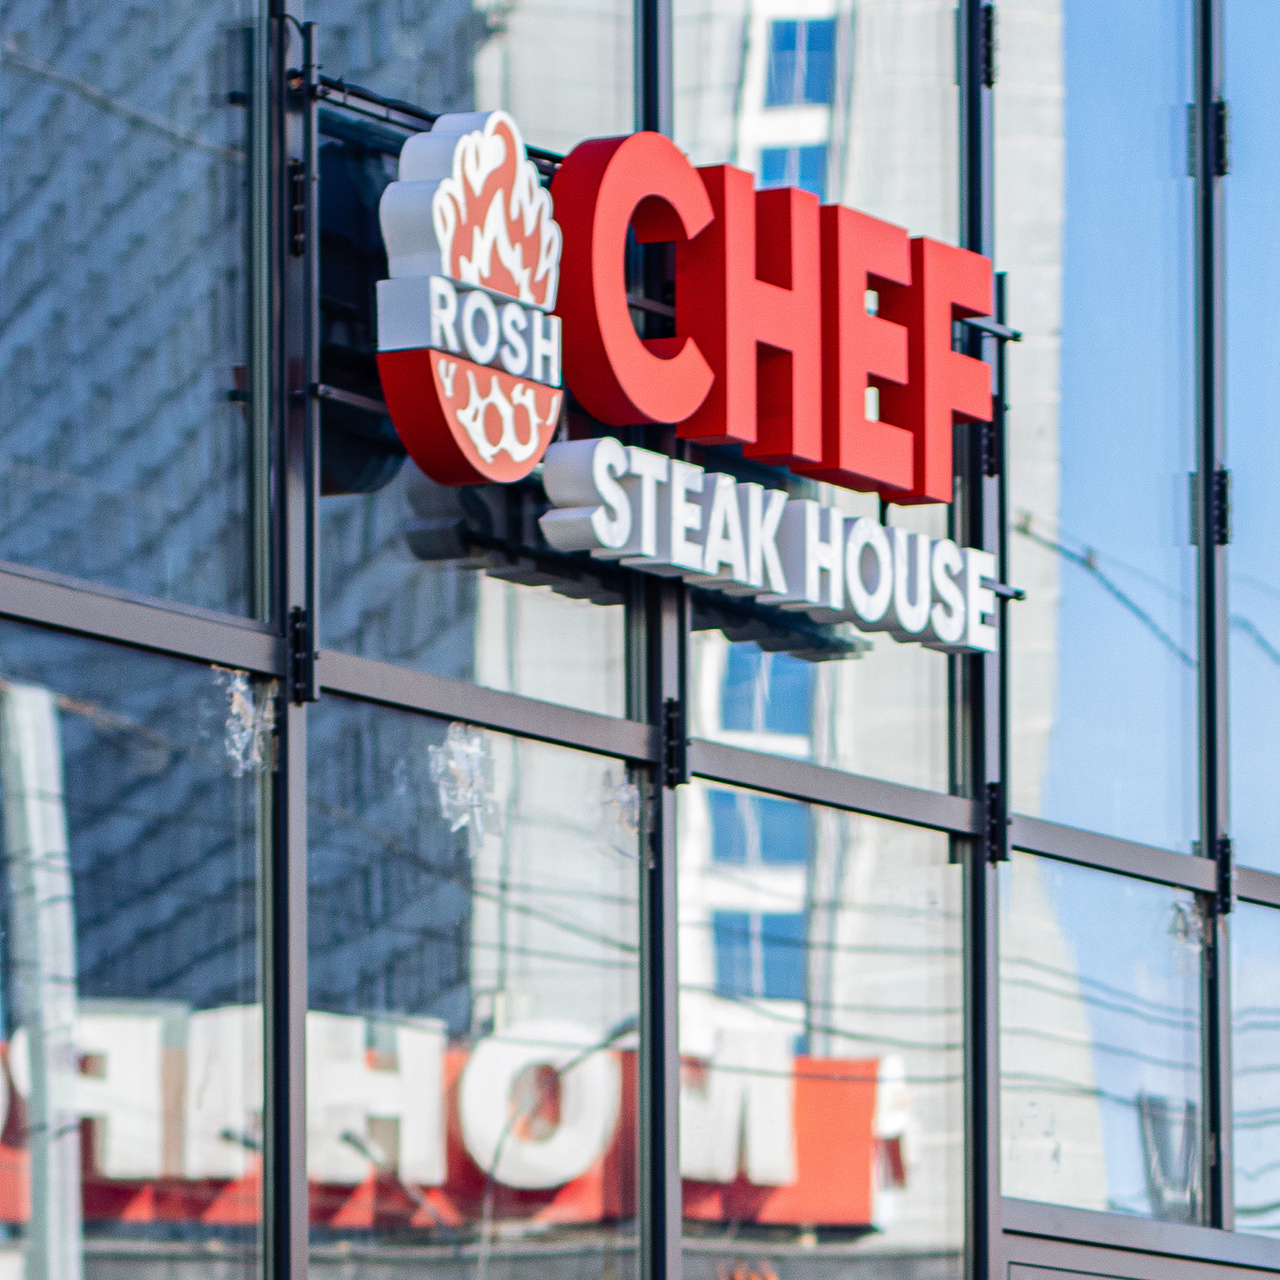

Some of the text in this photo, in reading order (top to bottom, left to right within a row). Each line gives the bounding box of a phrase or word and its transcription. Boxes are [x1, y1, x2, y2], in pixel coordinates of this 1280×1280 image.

[428, 275, 562, 388] ROSH
[572, 130, 993, 504] CHEF
[591, 437, 998, 654] STEAK HOUSE
